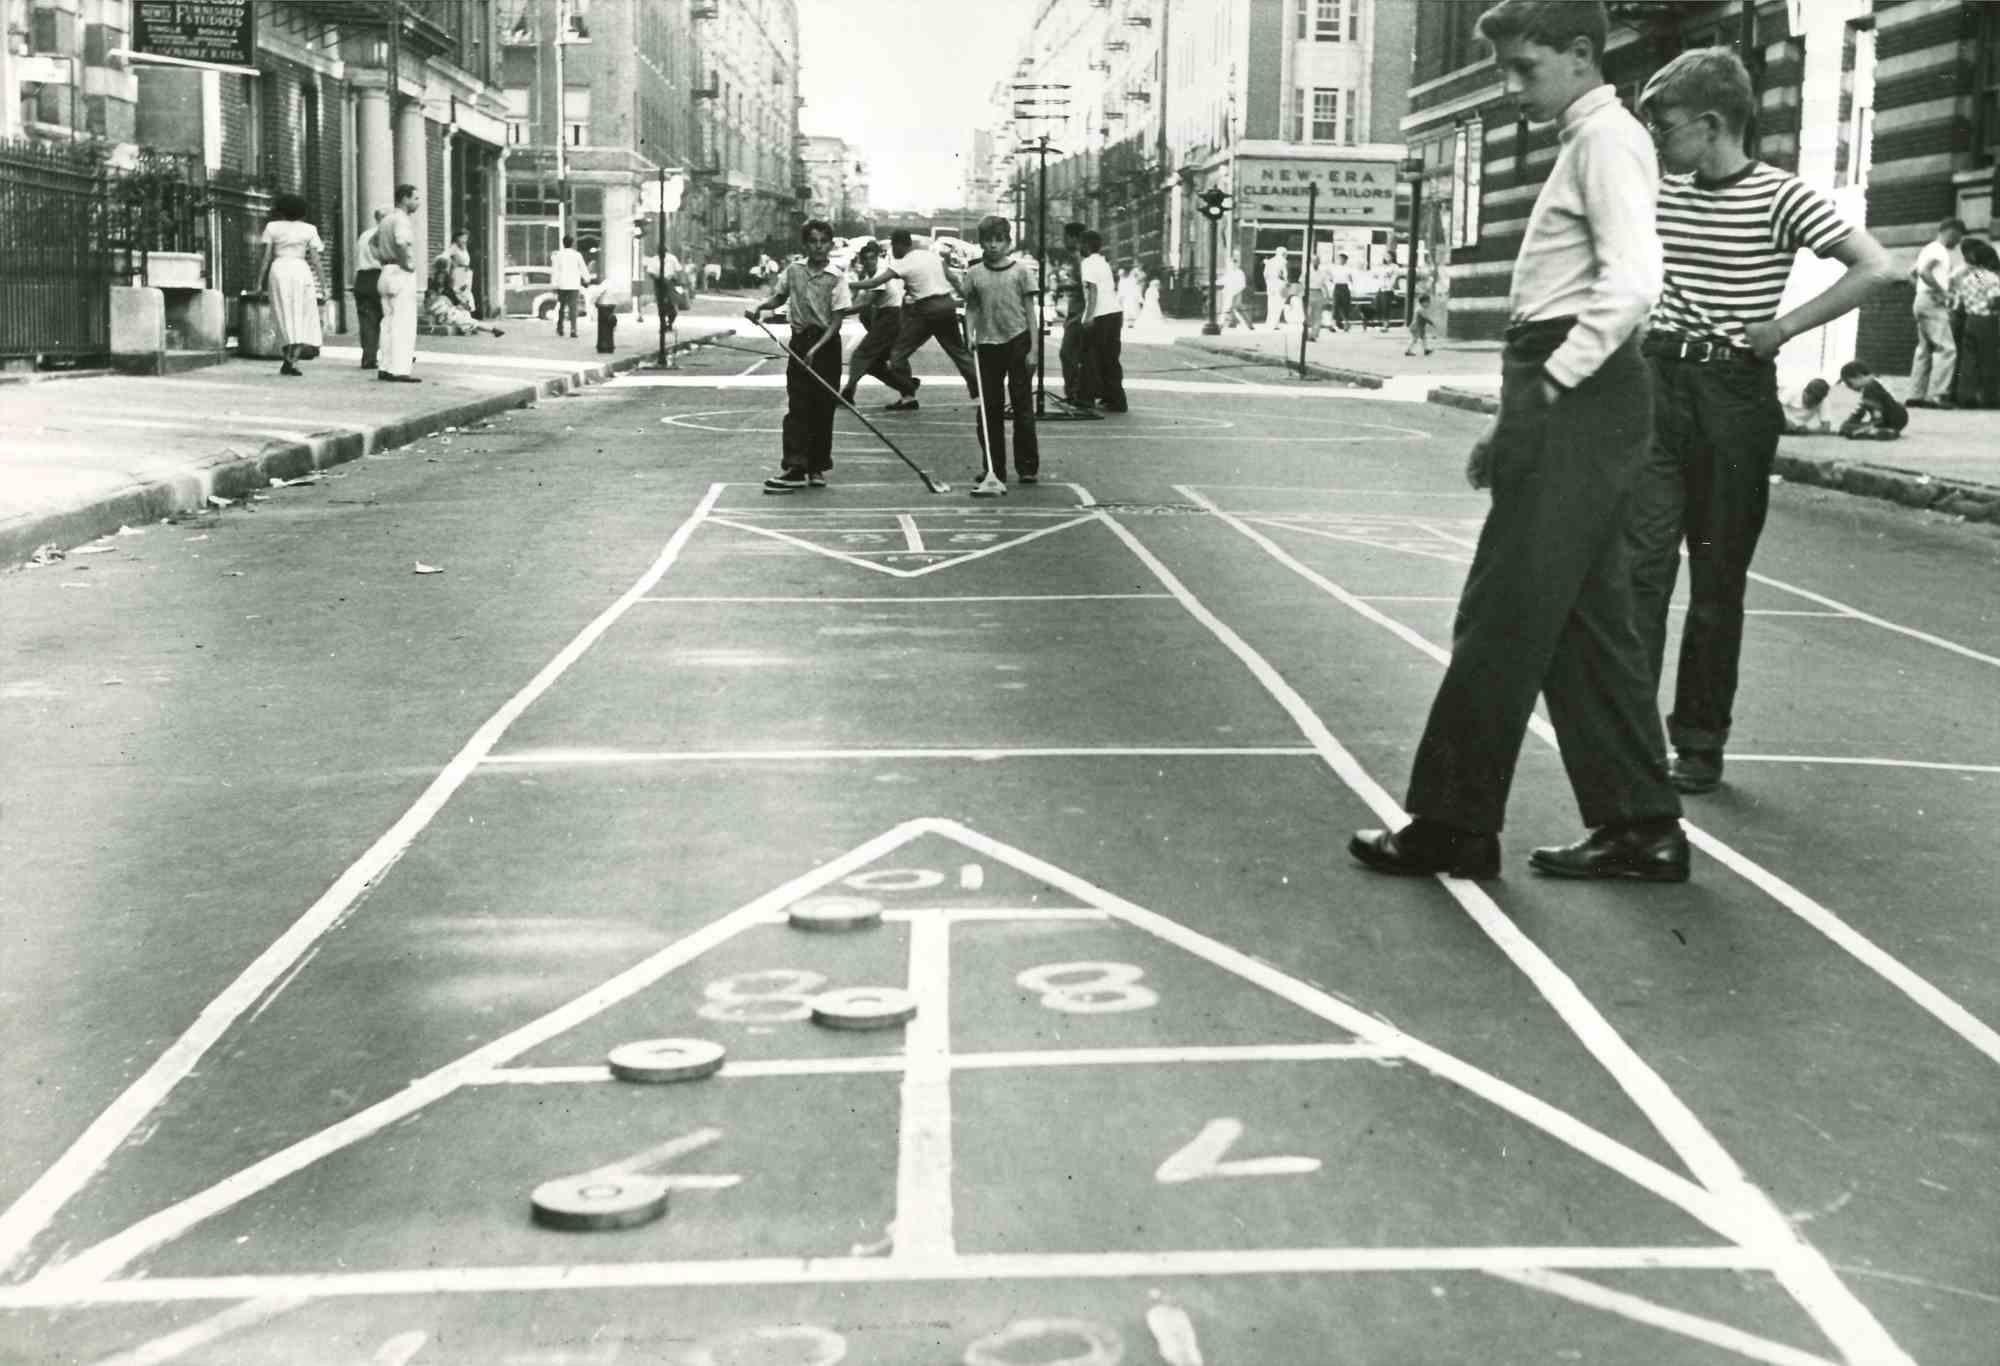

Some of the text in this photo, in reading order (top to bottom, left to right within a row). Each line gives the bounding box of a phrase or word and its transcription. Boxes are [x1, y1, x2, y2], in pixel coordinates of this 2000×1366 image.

[185, 15, 243, 28] STUDIOS
[210, 49, 245, 60] RATES
[1331, 187, 1393, 199] TAILORS
[1016, 961, 1159, 1013] 8
[1155, 1117, 1322, 1183] 7
